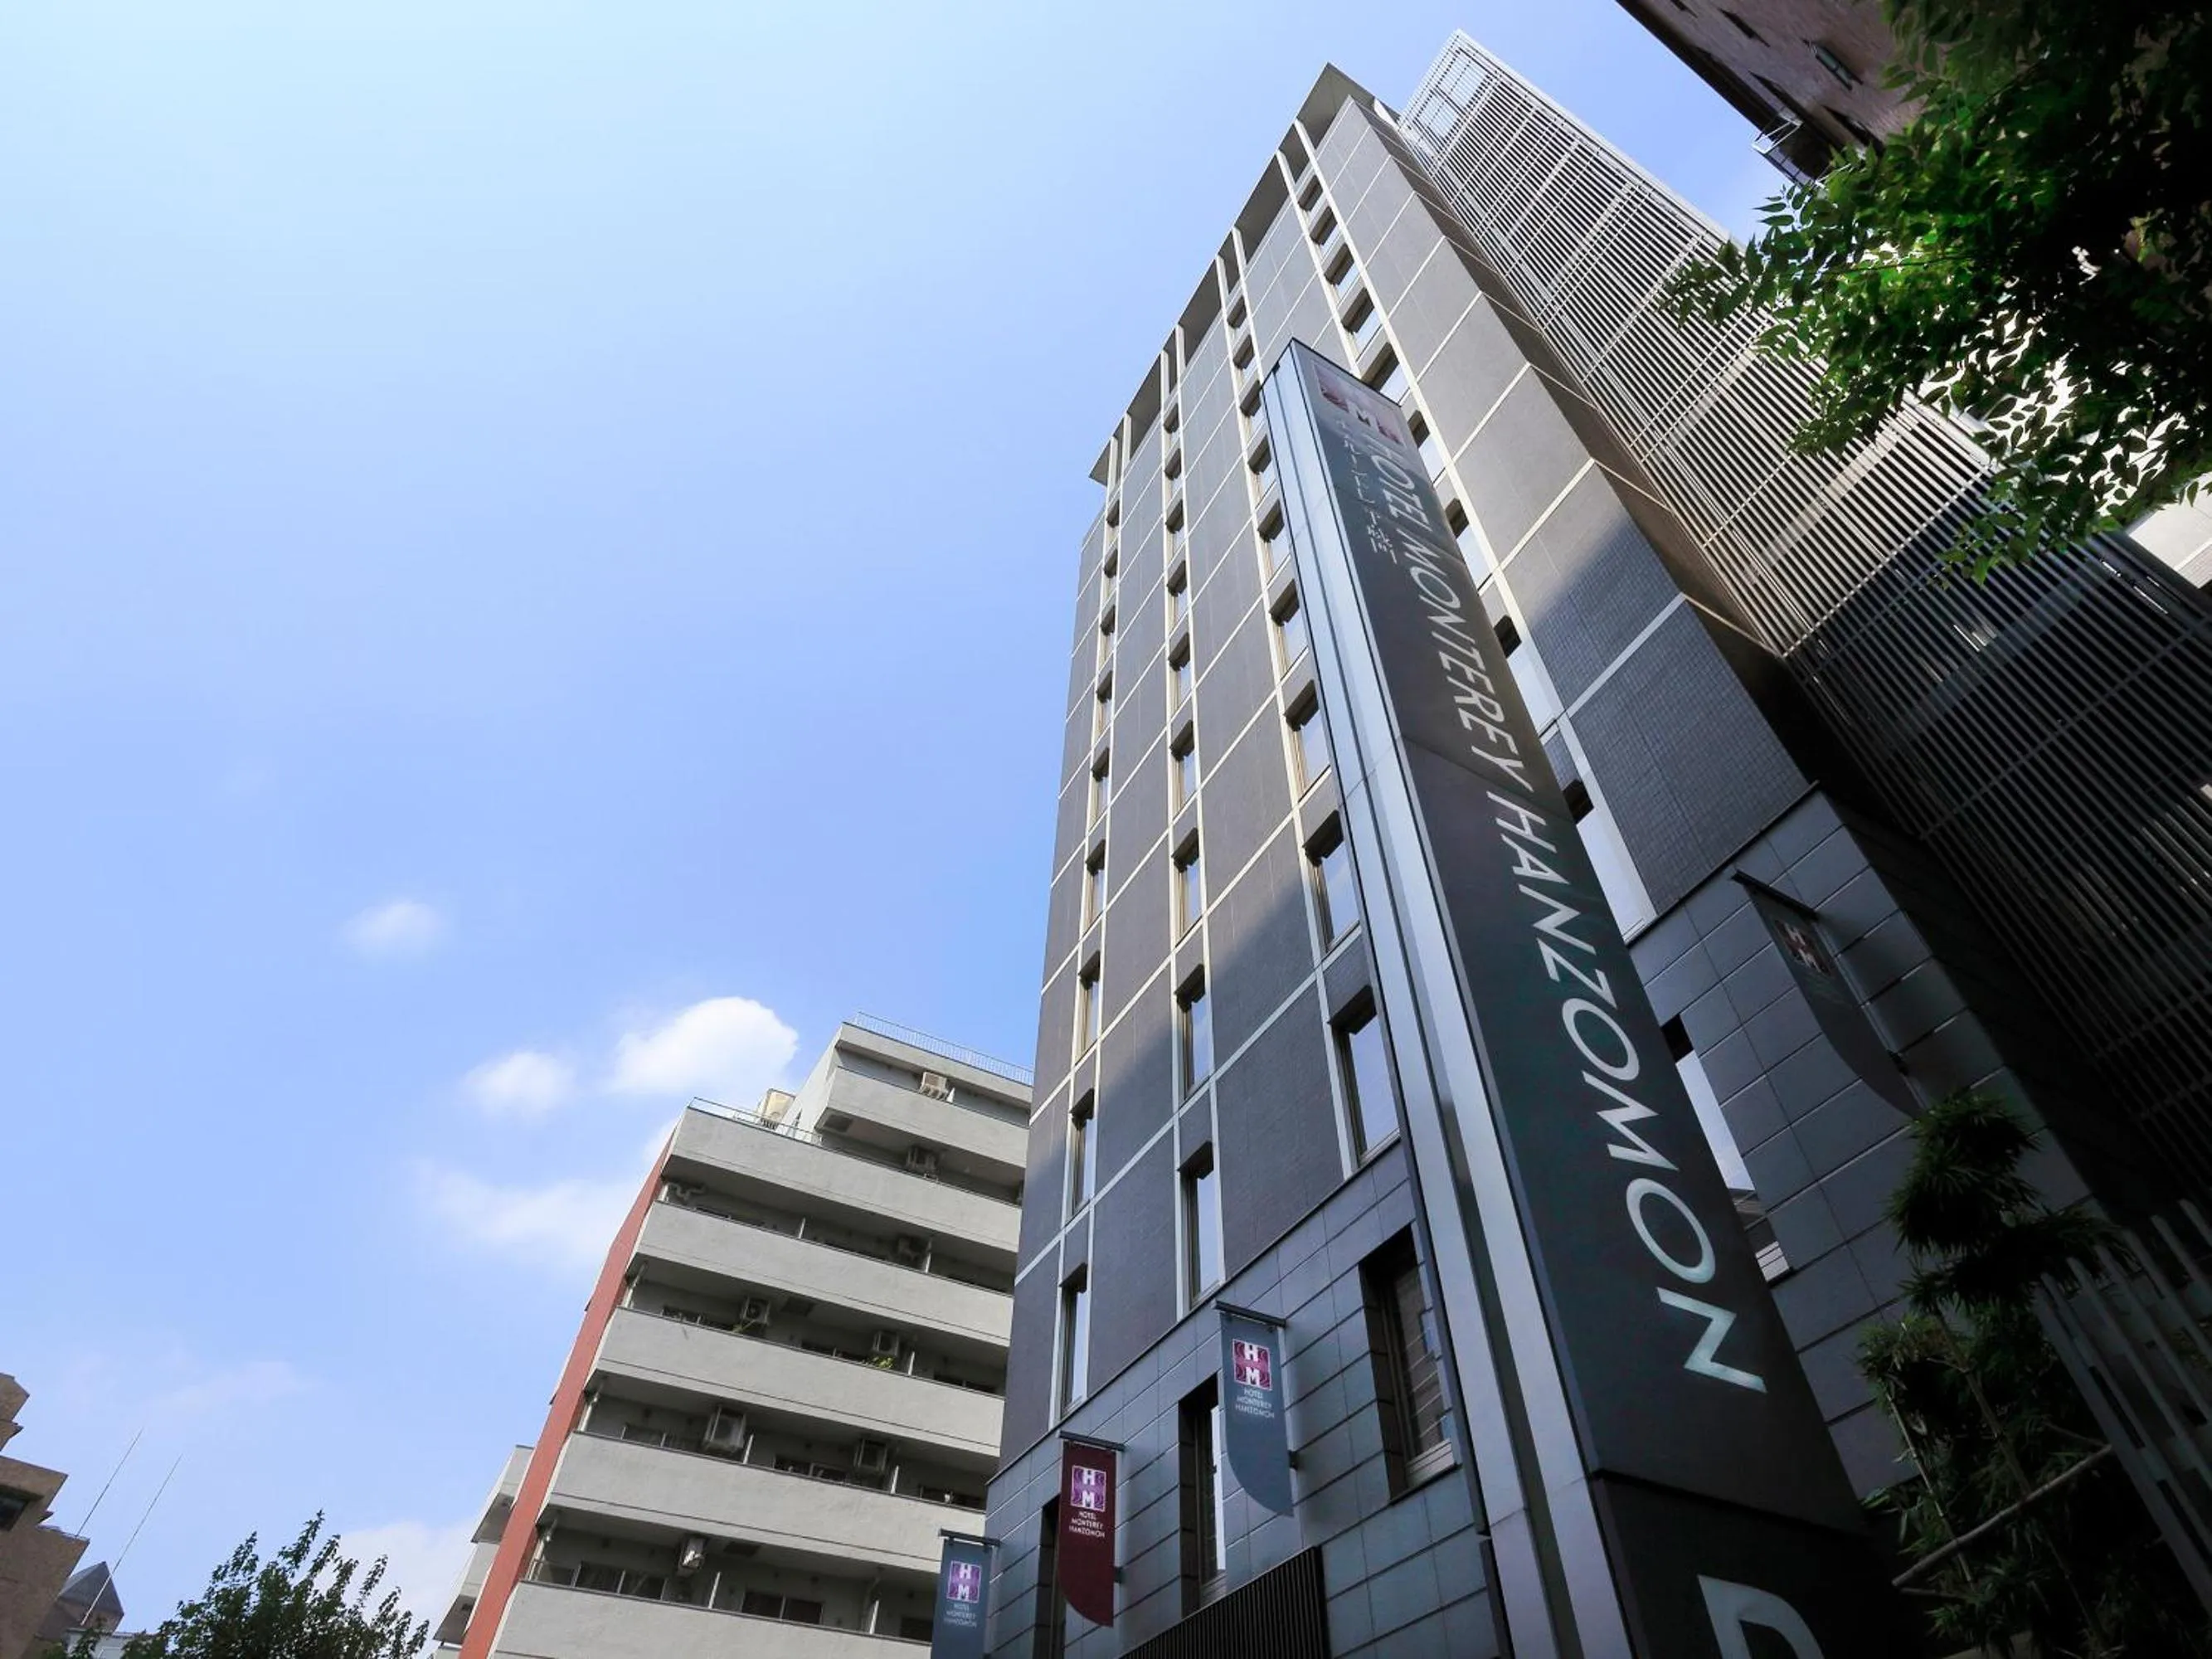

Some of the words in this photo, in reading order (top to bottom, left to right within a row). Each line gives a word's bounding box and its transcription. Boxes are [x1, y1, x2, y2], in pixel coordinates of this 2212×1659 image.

[1364, 432, 1433, 533] HOTEL
[1396, 527, 1534, 792] MONTEREY
[1486, 791, 1767, 1394] HANZOMON
[1245, 1343, 1258, 1362] H
[1246, 1366, 1260, 1387] M
[1082, 1468, 1095, 1486] H
[1082, 1490, 1095, 1508] M
